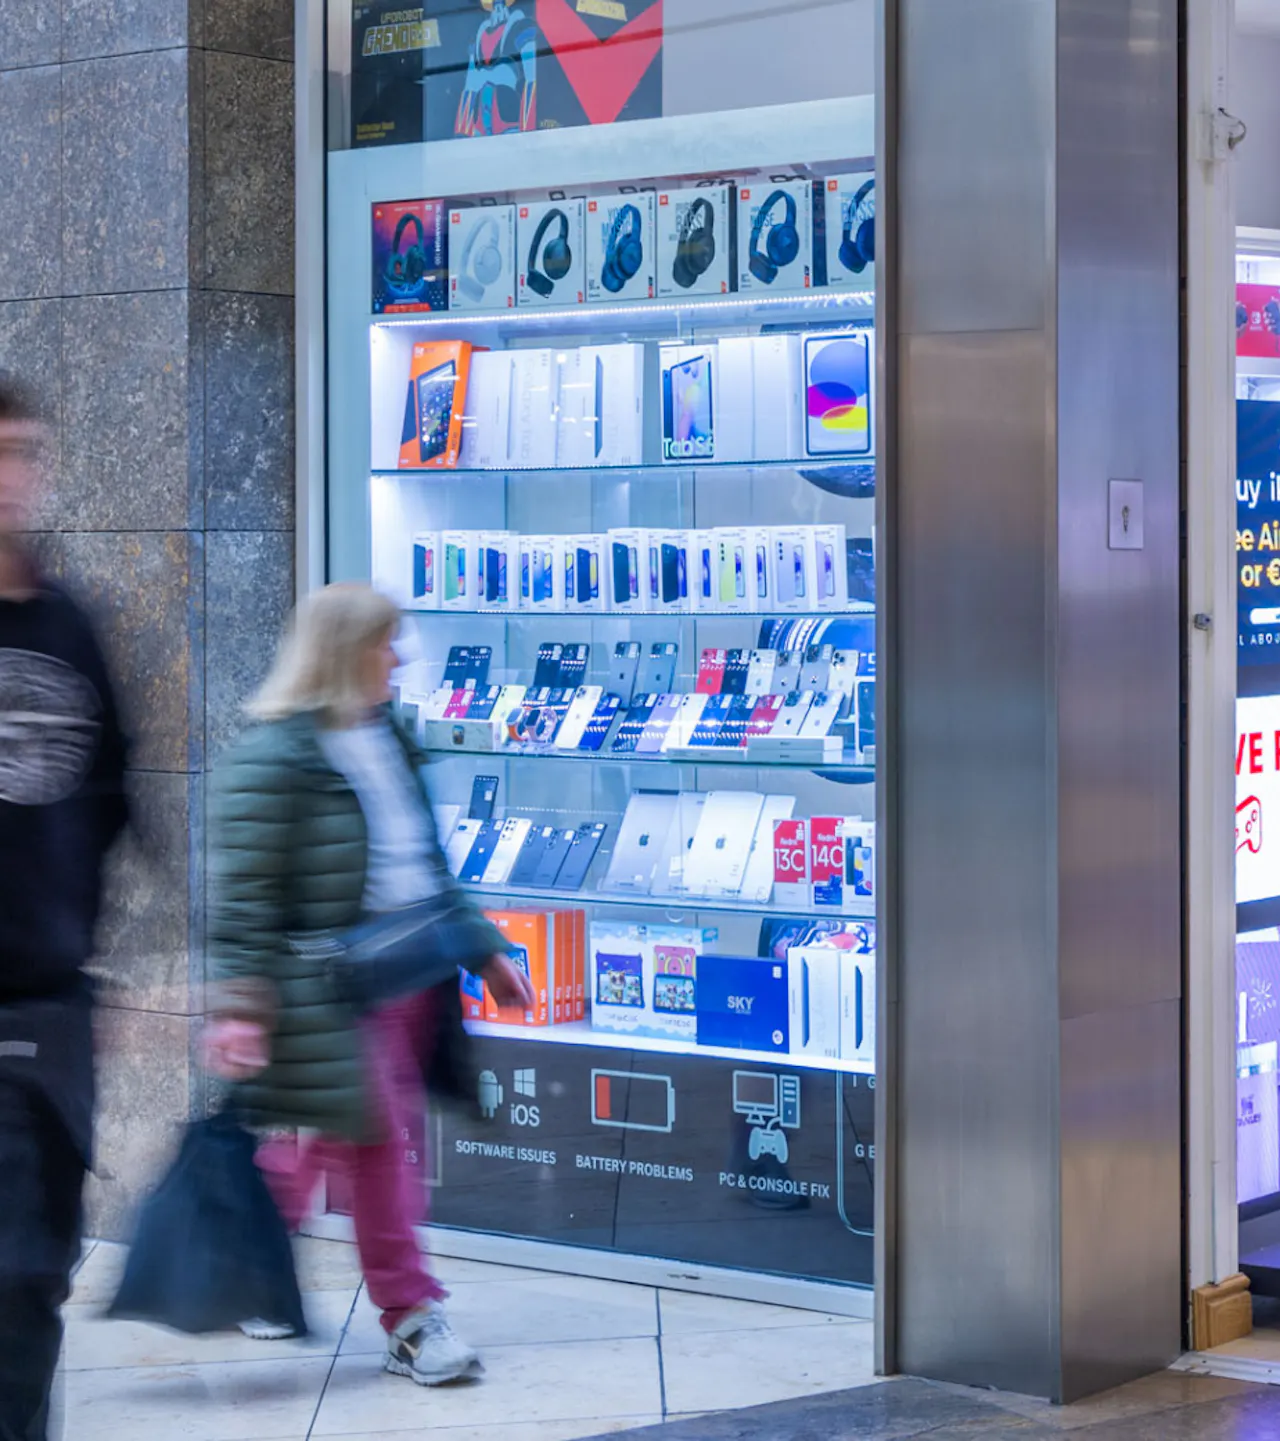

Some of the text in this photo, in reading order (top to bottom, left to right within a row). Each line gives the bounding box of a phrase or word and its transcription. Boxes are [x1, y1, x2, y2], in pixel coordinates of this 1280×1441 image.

[1236, 477, 1262, 508] uy
[1236, 530, 1254, 551] ee
[1241, 565, 1263, 587] or
[1235, 732, 1263, 776] VE
[775, 848, 804, 872] 13C
[811, 844, 844, 868] 14C
[727, 995, 753, 1010] SKY
[510, 1103, 540, 1127] iOS
[455, 1139, 557, 1165] SOFTWARE ISSUES
[575, 1154, 693, 1182] BATTERY PROBLEMS
[719, 1171, 830, 1198] PC & CONSOLE FIX
